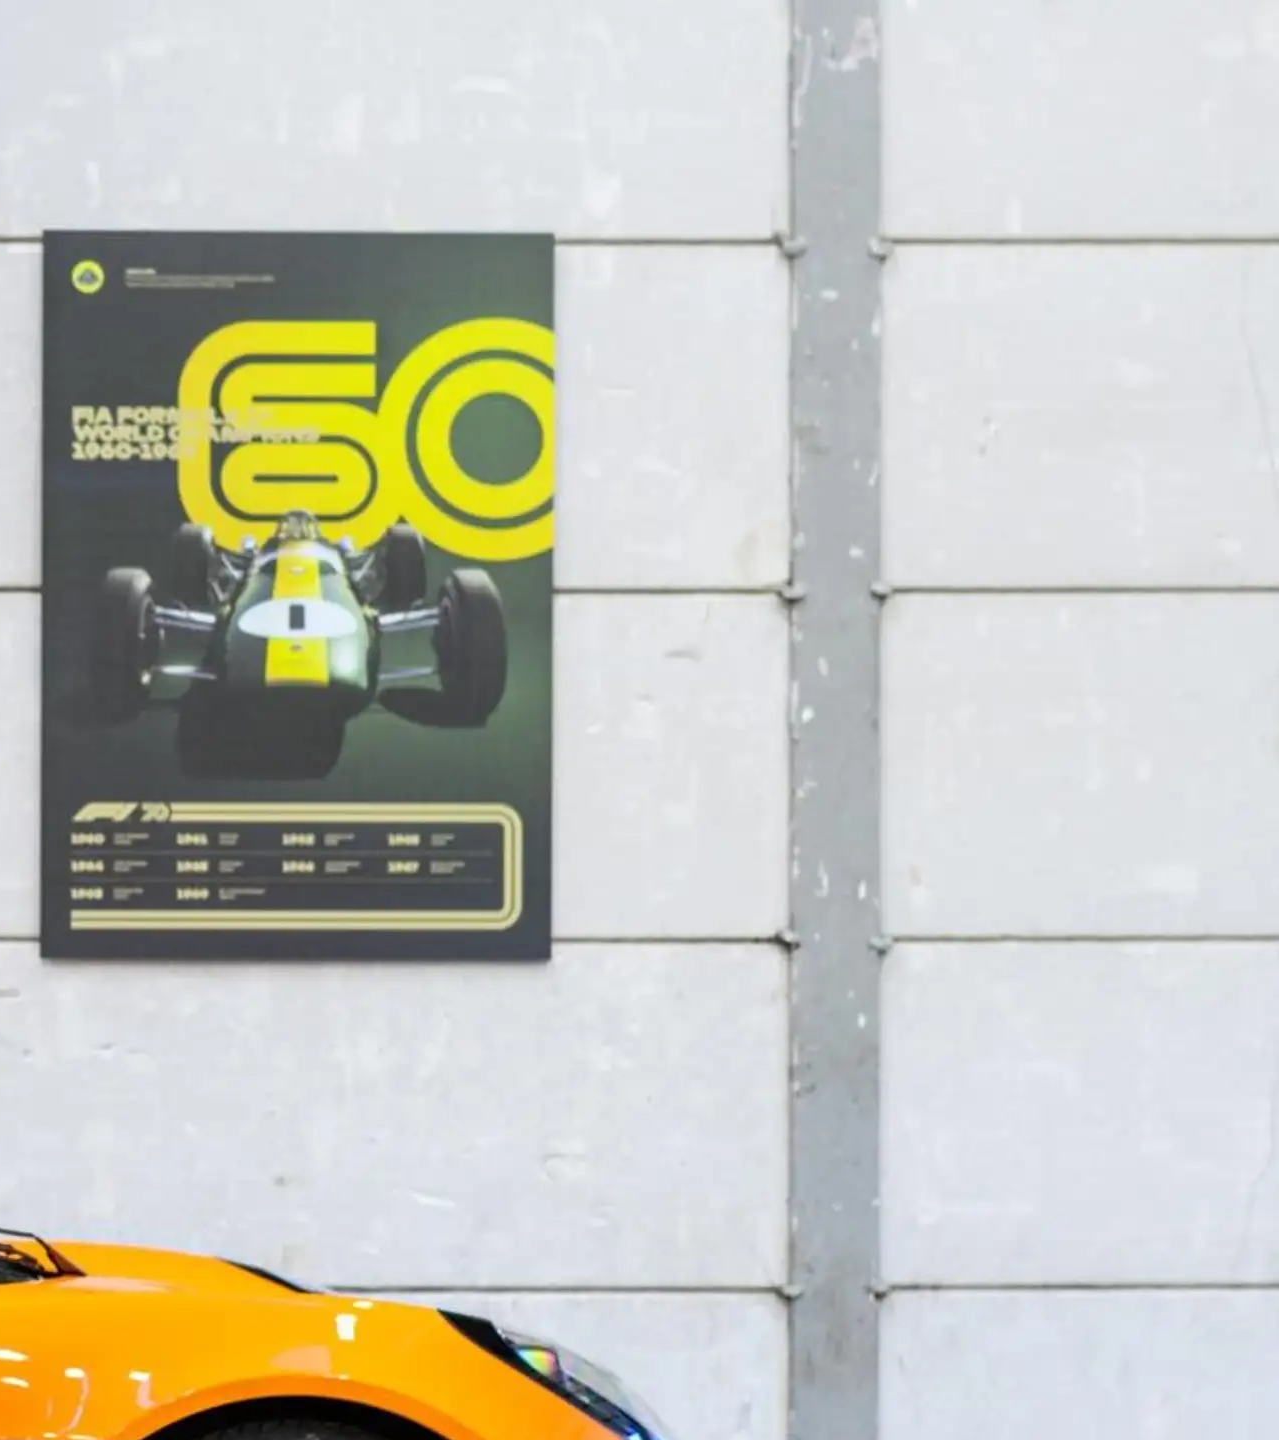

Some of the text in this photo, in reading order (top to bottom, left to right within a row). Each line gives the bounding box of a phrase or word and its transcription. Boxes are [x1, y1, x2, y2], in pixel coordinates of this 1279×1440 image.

[73, 424, 166, 443] WORLD
[178, 317, 554, 562] 60
[288, 603, 306, 631] 1
